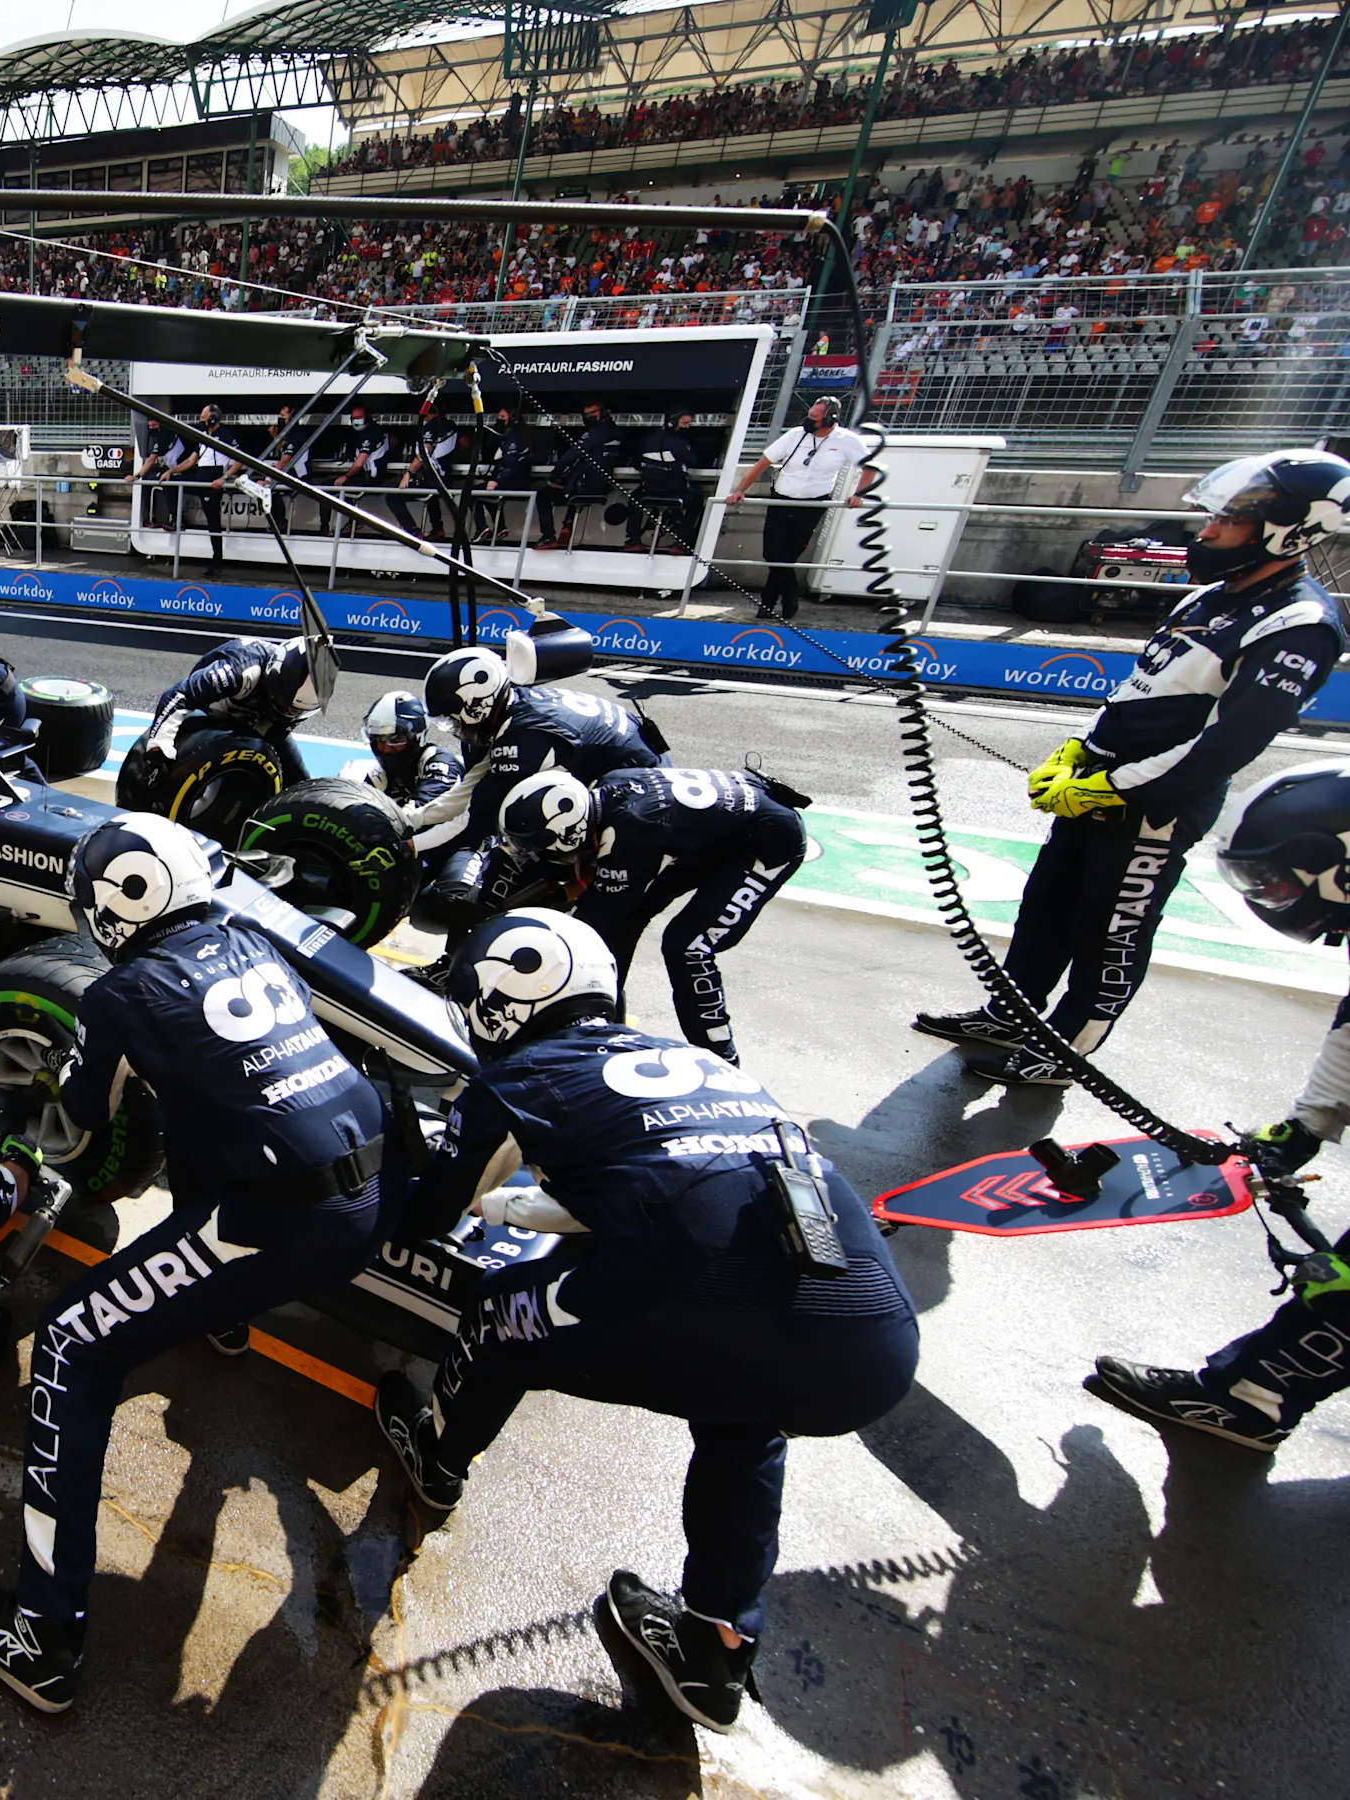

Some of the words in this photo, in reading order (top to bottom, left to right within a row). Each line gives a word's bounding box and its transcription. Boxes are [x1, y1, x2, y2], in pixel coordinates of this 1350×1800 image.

[96, 459, 123, 469] GASLY
[197, 760, 213, 781] P
[220, 749, 278, 776] ZERO
[687, 868, 766, 1021] ALPHATAURI
[1094, 844, 1171, 1016] ALPHATAURI
[261, 1055, 350, 1105] HONDA
[27, 1237, 214, 1502] ALPHATAURI
